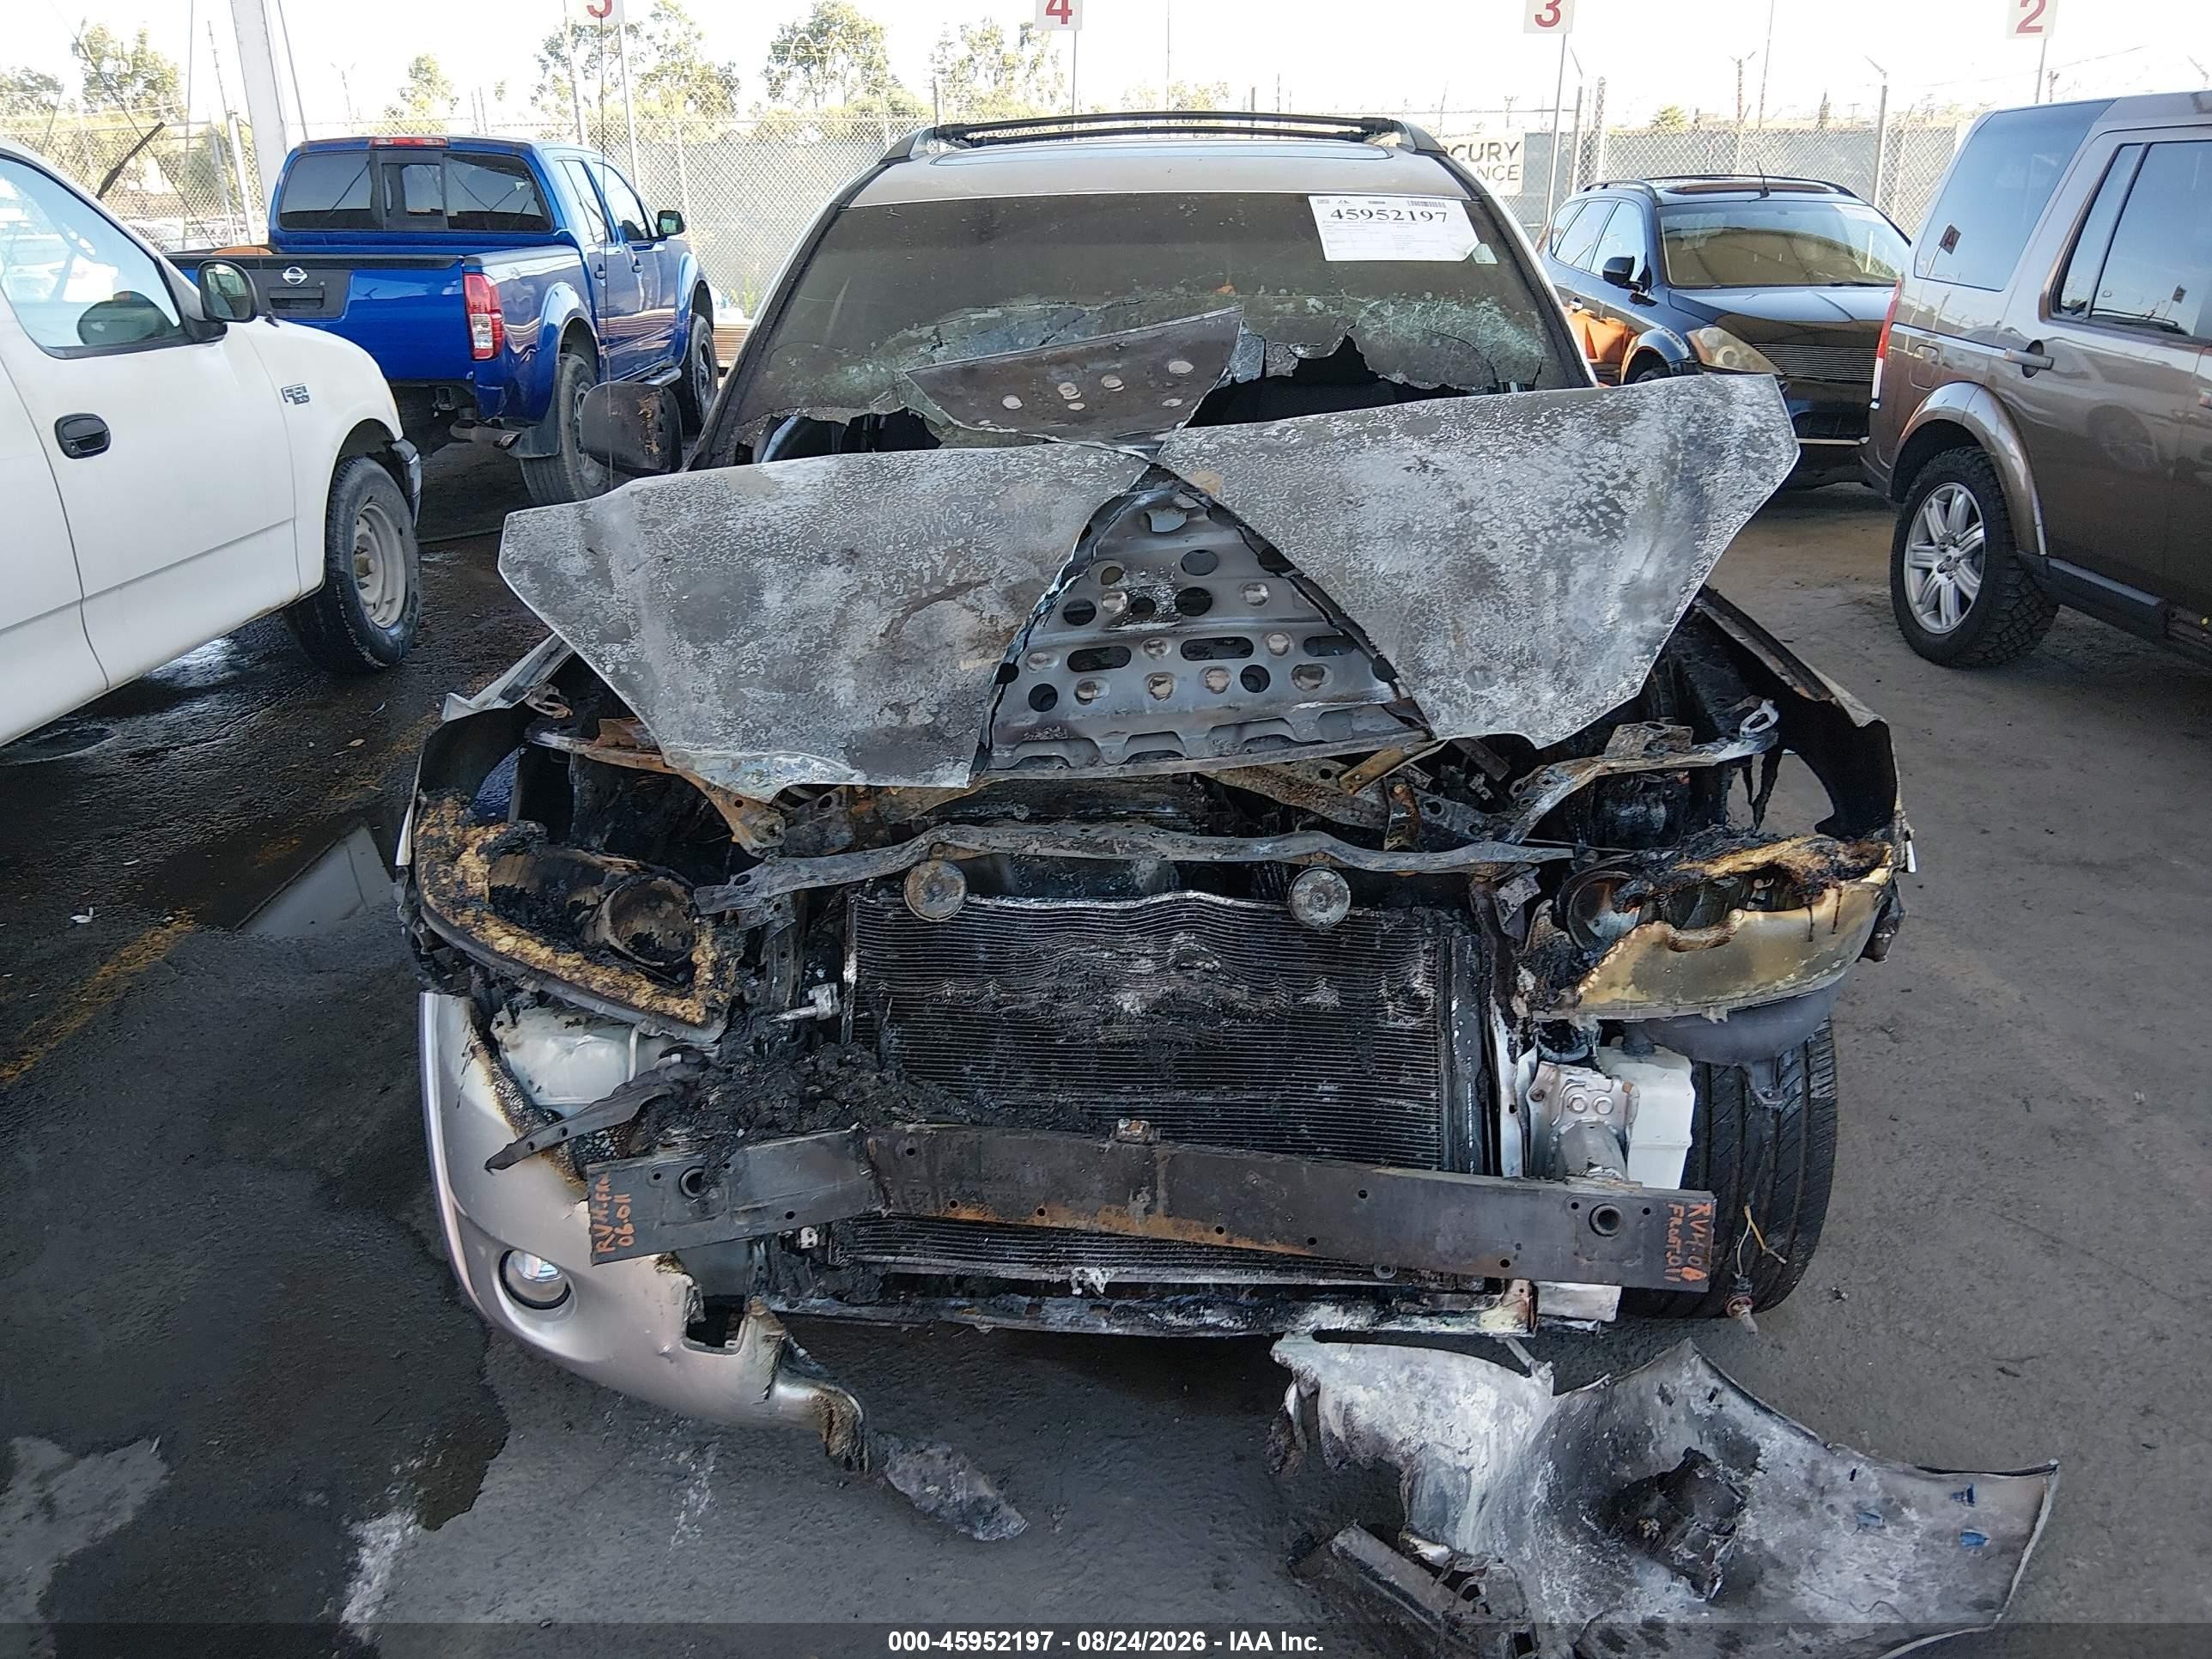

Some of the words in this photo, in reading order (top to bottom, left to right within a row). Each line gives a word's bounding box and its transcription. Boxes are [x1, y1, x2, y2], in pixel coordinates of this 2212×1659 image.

[1045, 0, 1073, 25] 4
[1534, 0, 1561, 27] 3
[2015, 0, 2046, 33] 2
[1330, 209, 1447, 222] 45952197
